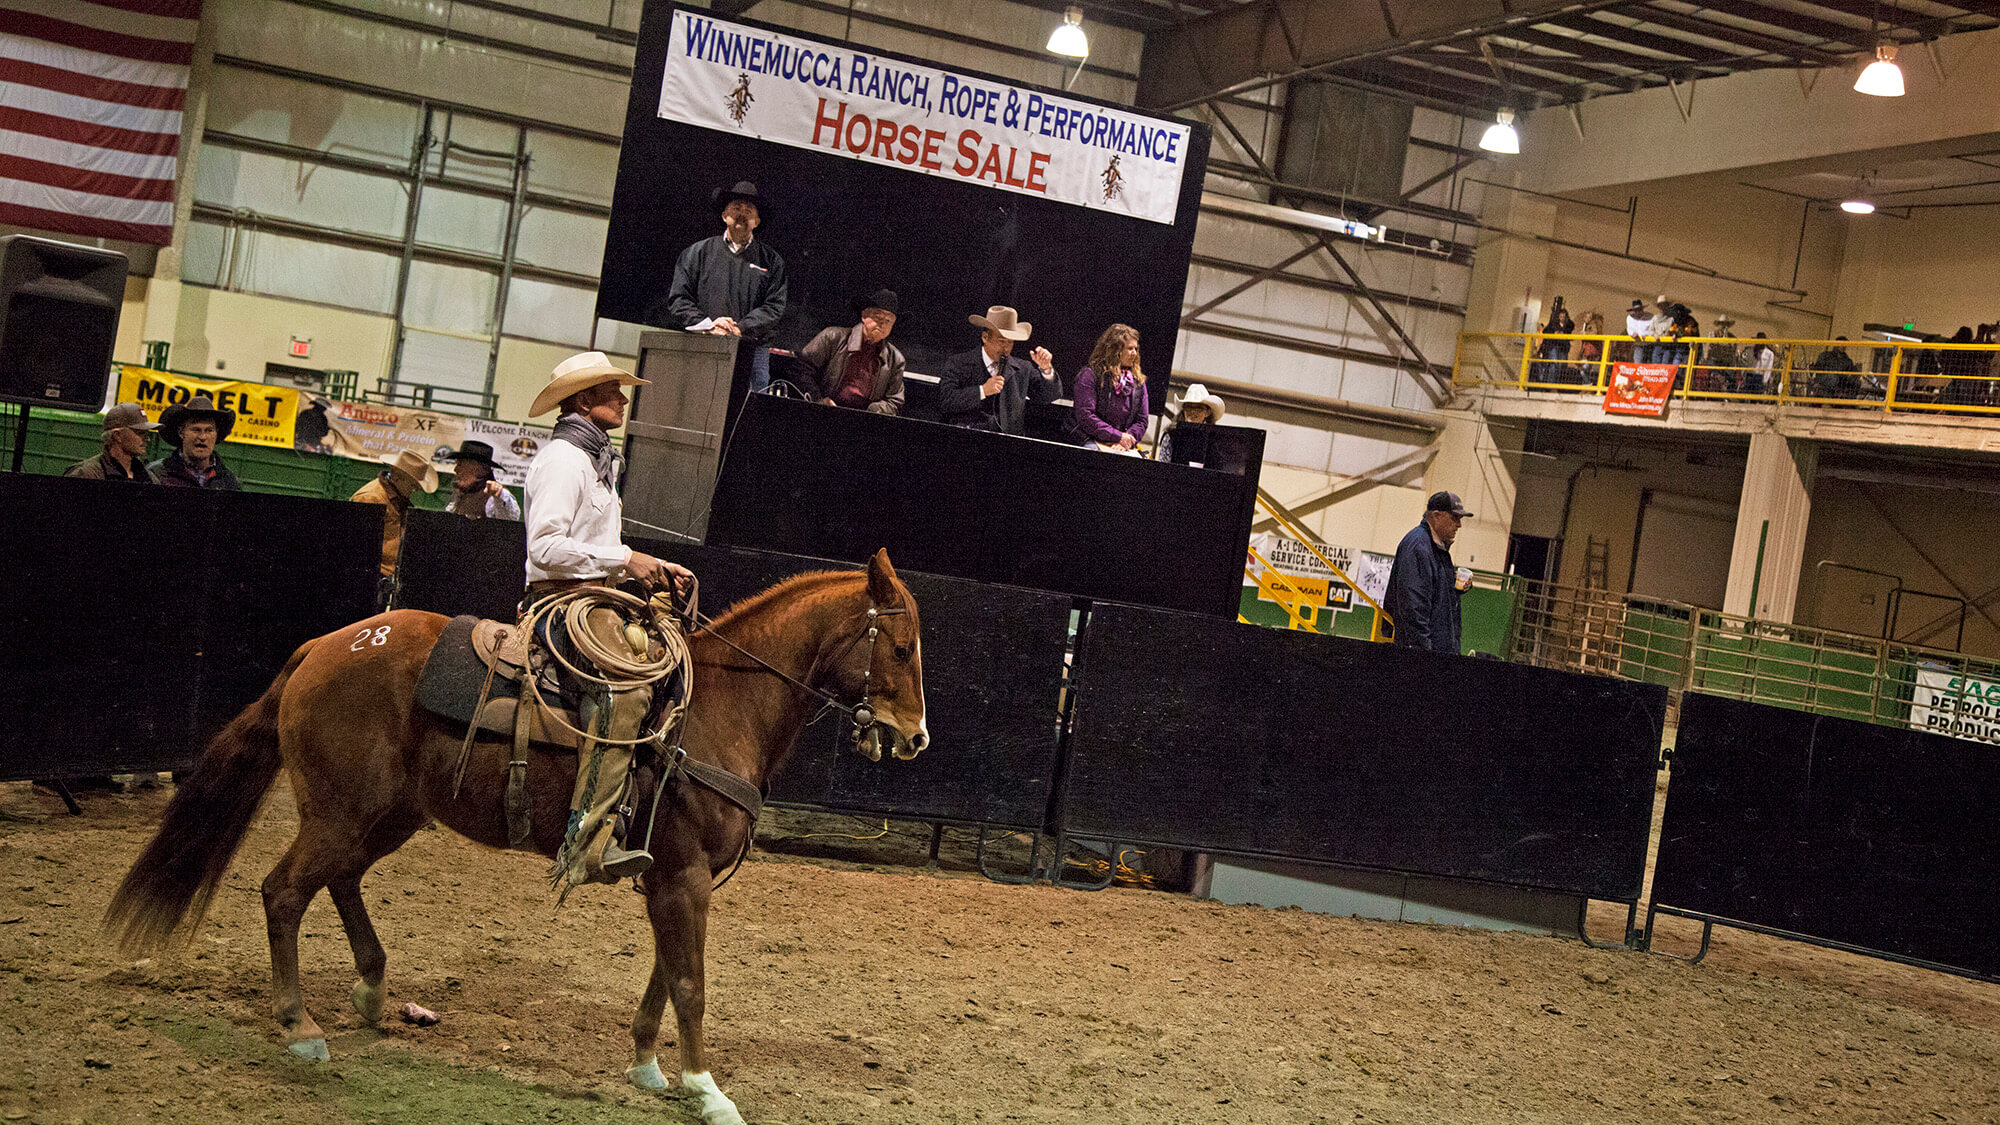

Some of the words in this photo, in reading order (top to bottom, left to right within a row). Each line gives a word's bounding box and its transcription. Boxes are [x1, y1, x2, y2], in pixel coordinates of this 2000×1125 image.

[685, 15, 842, 91] WINNEMUCCA
[848, 54, 932, 118] RANCH,
[939, 75, 1000, 125] ROPE
[1003, 89, 1021, 129] &
[1024, 93, 1181, 164] PERFORMANCE
[810, 97, 947, 171] HORSE
[952, 129, 1051, 194] SALE
[264, 396, 283, 419] T
[247, 417, 280, 428] CASINO
[471, 420, 516, 435] WELCOME
[518, 428, 549, 440] RANCH
[345, 424, 385, 440] Mineral
[386, 429, 396, 441] &
[398, 432, 436, 446] Protein
[1270, 550, 1307, 566] SERVICE
[1308, 556, 1352, 572] COMANY
[1276, 540, 1290, 551] A-1
[1292, 541, 1349, 560] COMERCIAL
[1270, 582, 1323, 597] CAMAN
[1329, 586, 1351, 603] CAT
[350, 625, 392, 652] 28
